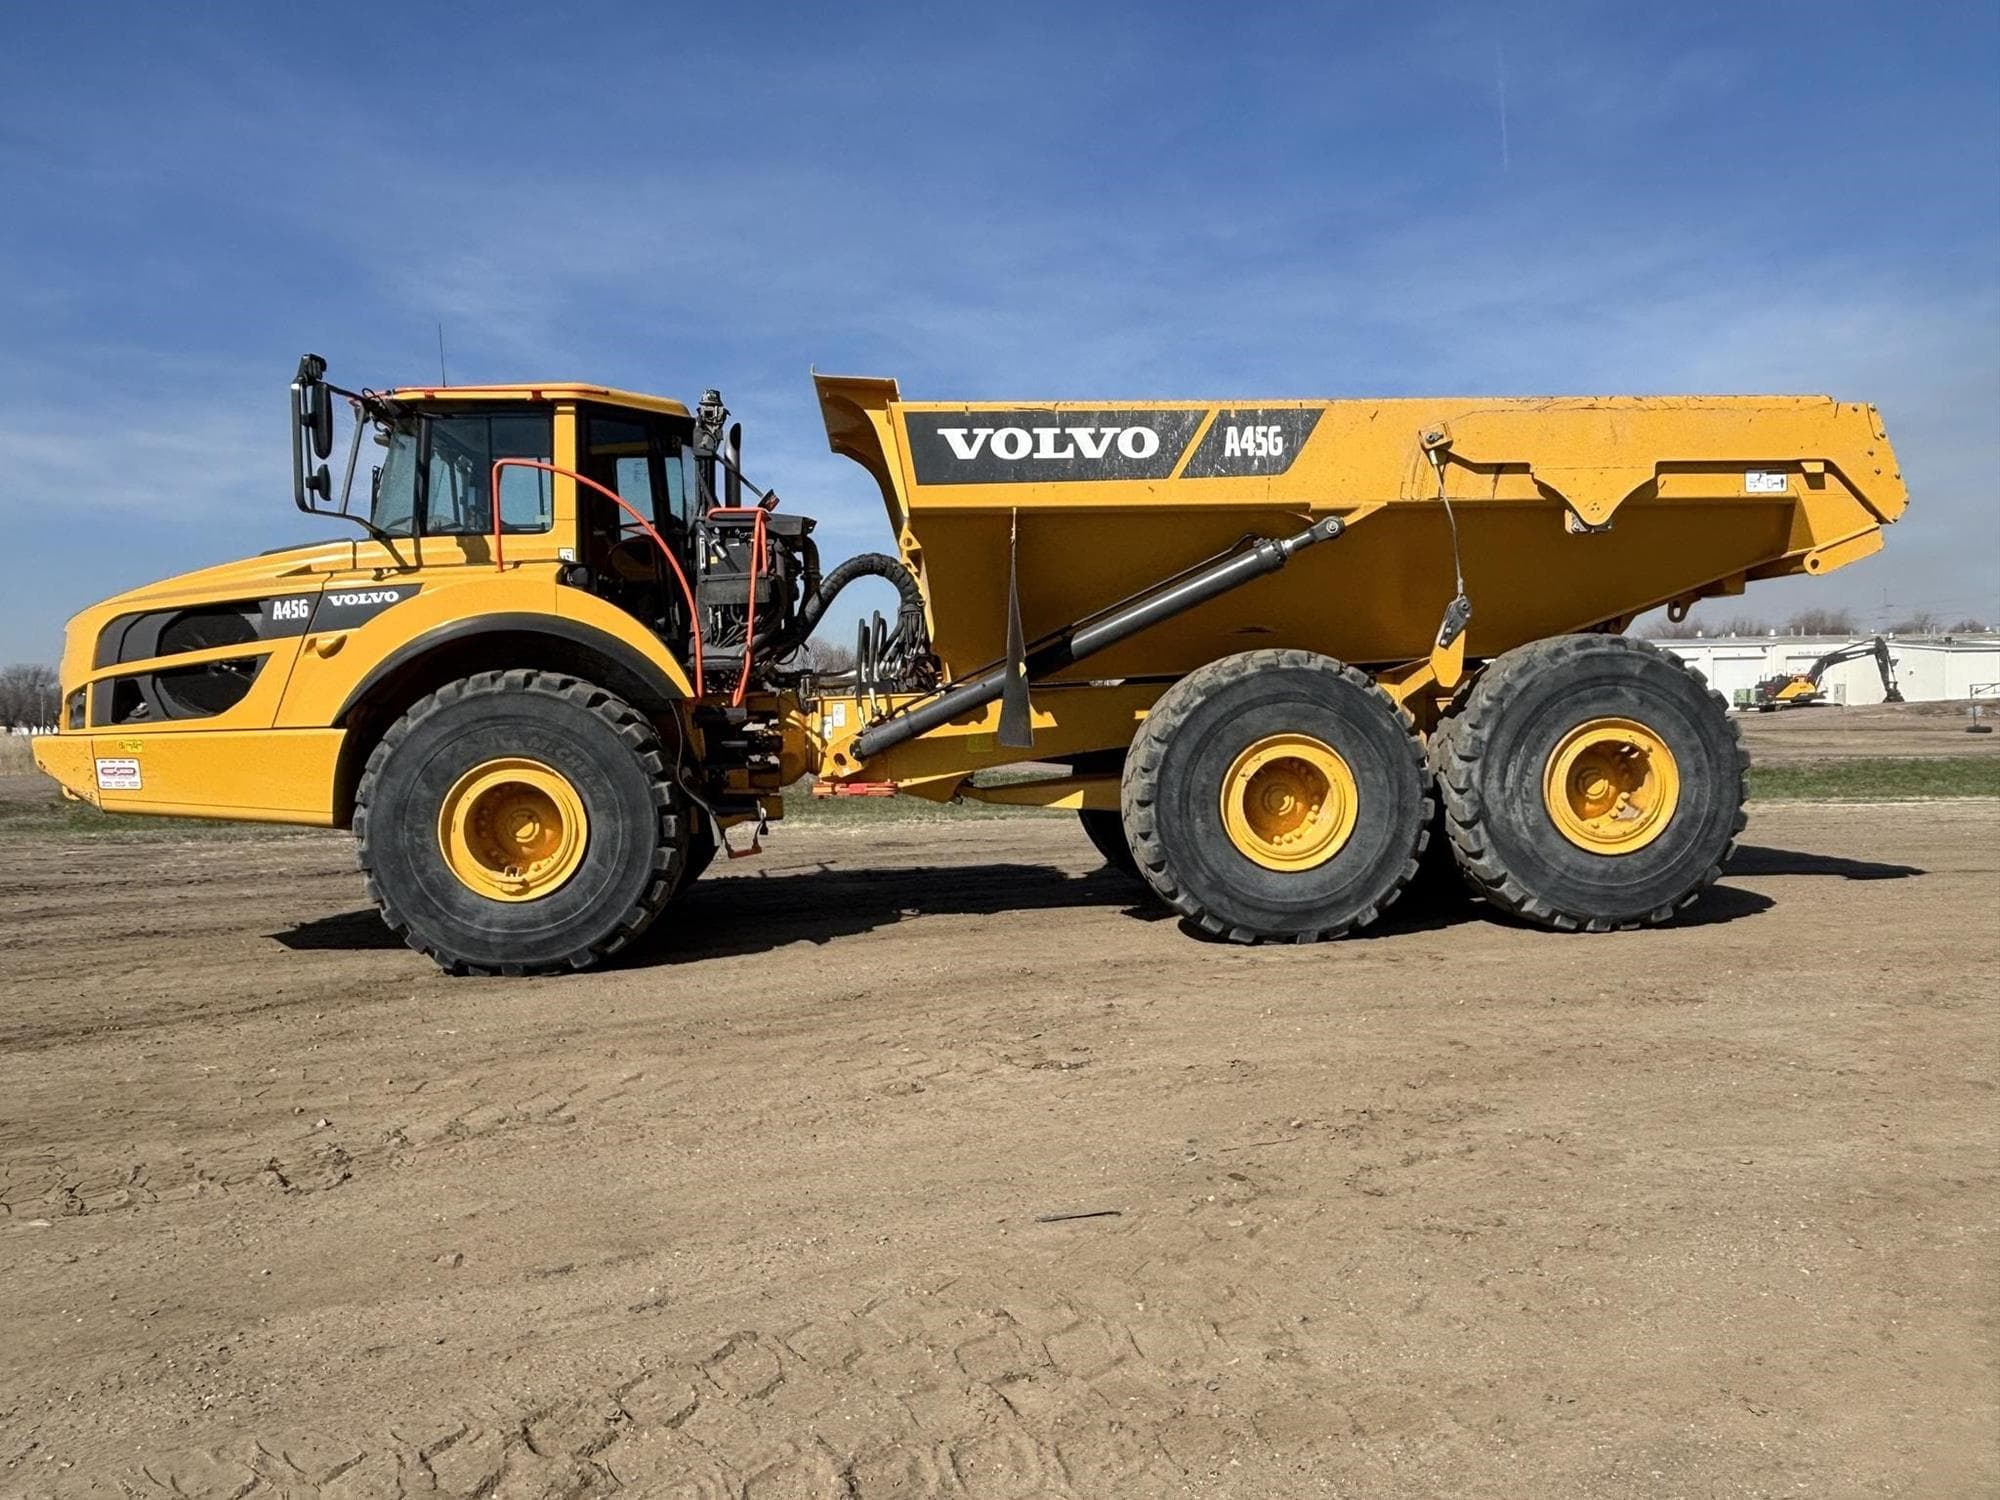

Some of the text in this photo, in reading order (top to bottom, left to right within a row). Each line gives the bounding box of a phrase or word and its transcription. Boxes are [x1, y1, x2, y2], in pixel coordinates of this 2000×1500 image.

[937, 425, 1283, 460] VOLVO A45G
[272, 591, 399, 620] A45G VOLVO
